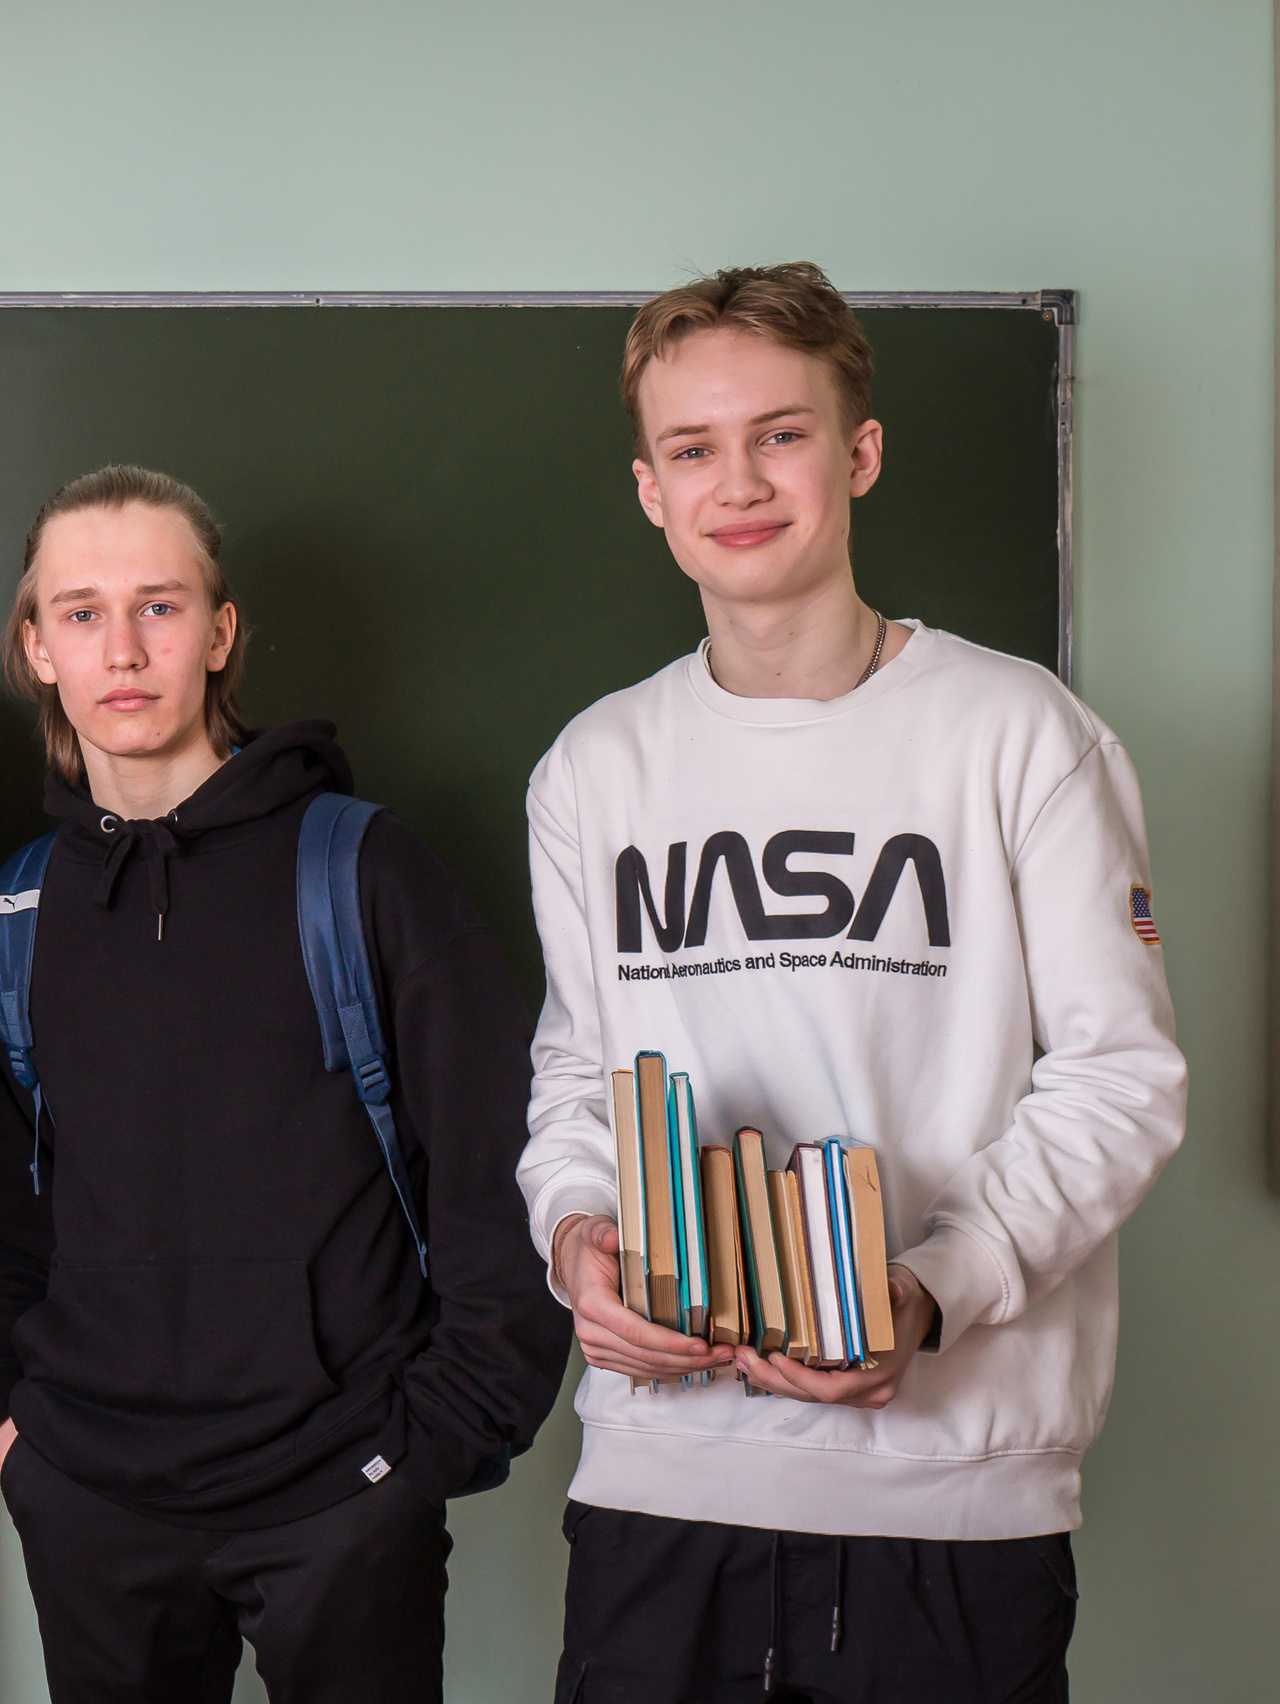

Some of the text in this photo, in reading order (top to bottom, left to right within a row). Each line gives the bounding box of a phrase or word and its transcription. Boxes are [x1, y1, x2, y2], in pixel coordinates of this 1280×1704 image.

[615, 829, 951, 953] NASA
[672, 958, 742, 979] Aeronautics
[745, 953, 775, 970] and
[779, 951, 827, 972] Space
[829, 951, 948, 977] Administration
